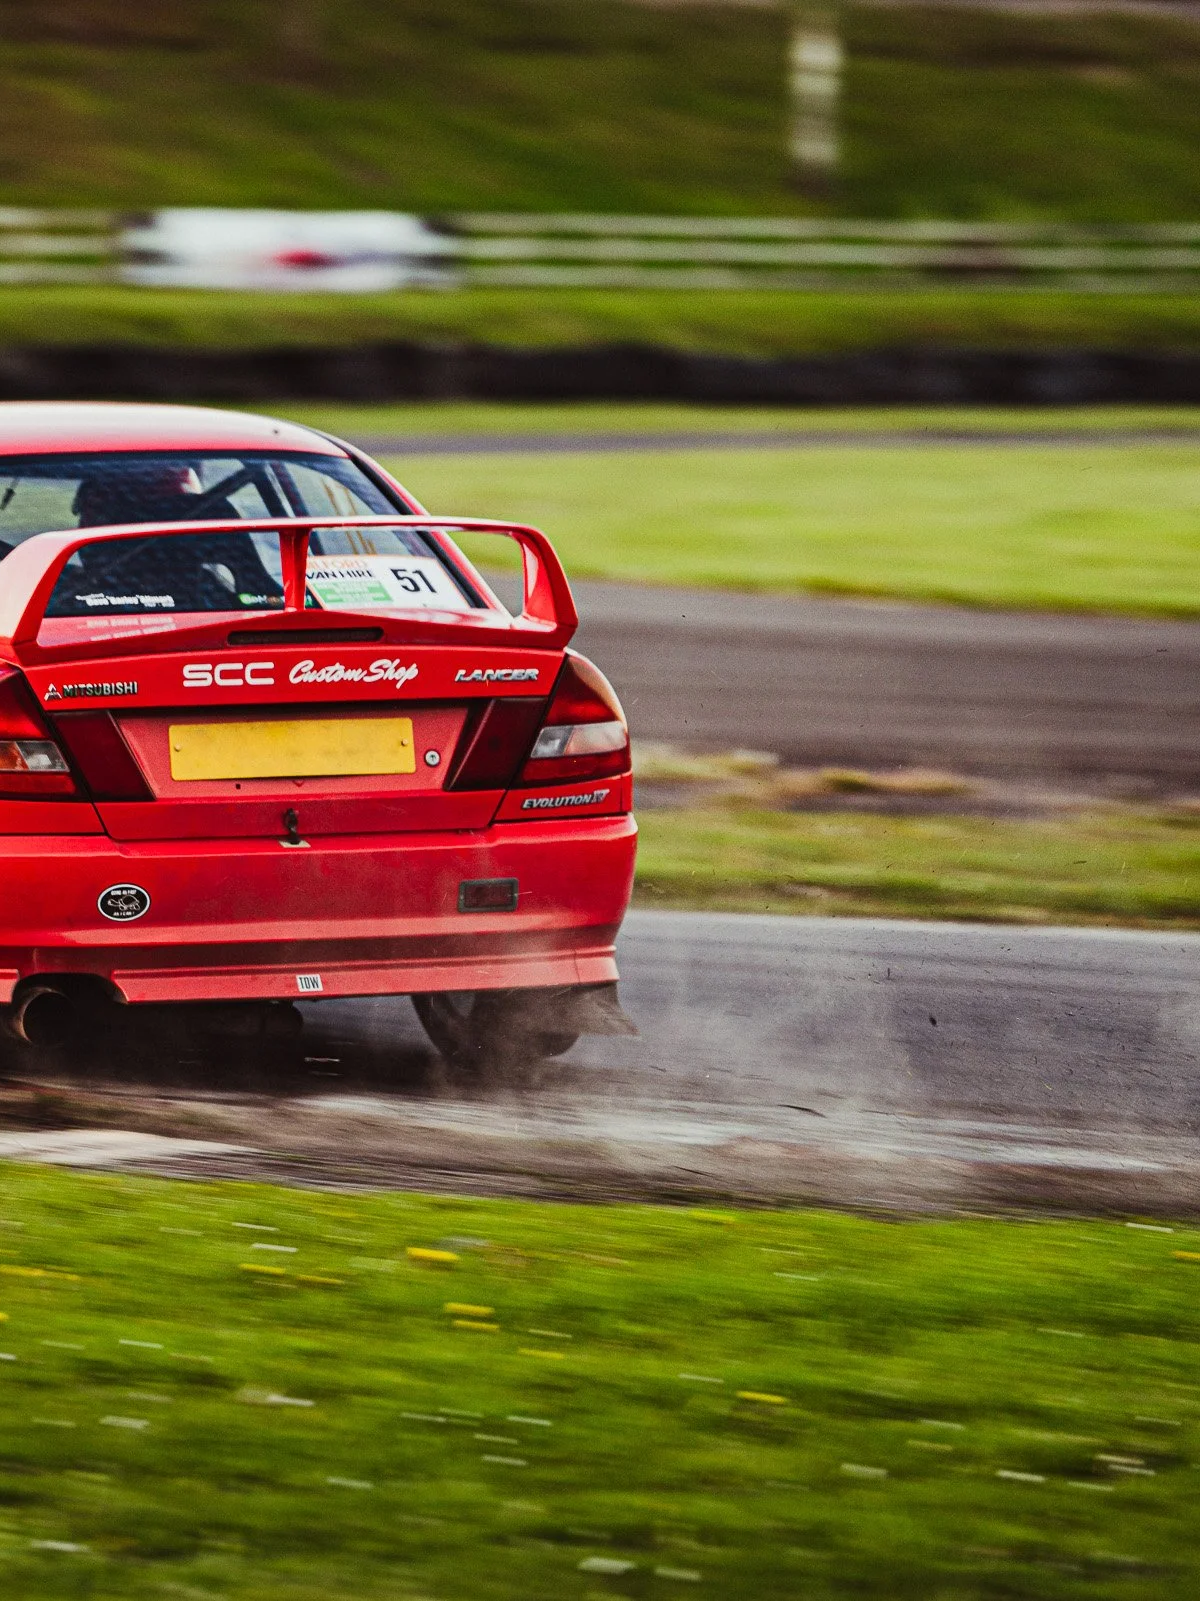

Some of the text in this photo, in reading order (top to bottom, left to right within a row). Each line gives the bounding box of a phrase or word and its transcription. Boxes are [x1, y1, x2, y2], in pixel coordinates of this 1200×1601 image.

[338, 569, 375, 578] HIRE
[389, 566, 438, 594] 51
[182, 658, 419, 690] SCC Custom Shop
[454, 668, 540, 682] LANCER
[62, 680, 138, 697] MITSUBISHI
[522, 794, 592, 809] EVOLUTION
[298, 976, 320, 990] TOW
